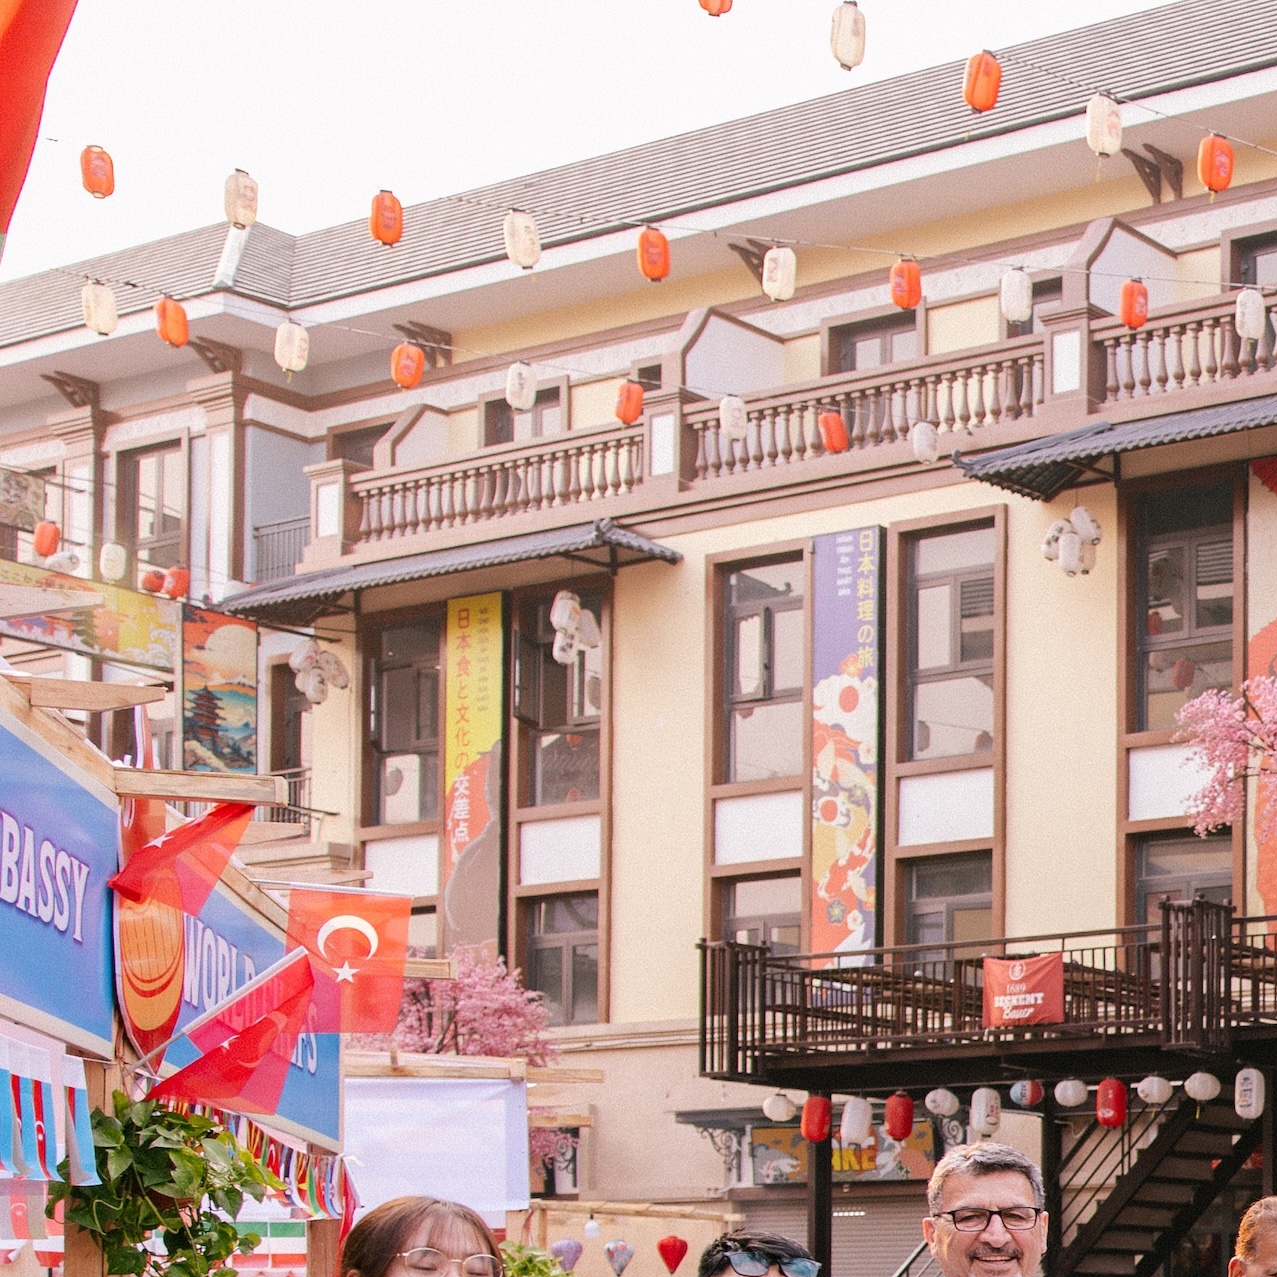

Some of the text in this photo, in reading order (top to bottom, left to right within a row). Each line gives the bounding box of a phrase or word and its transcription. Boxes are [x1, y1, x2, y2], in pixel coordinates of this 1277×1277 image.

[857, 530, 875, 668] 日本料理の旅
[454, 608, 470, 843] 日本食と文化の交差点
